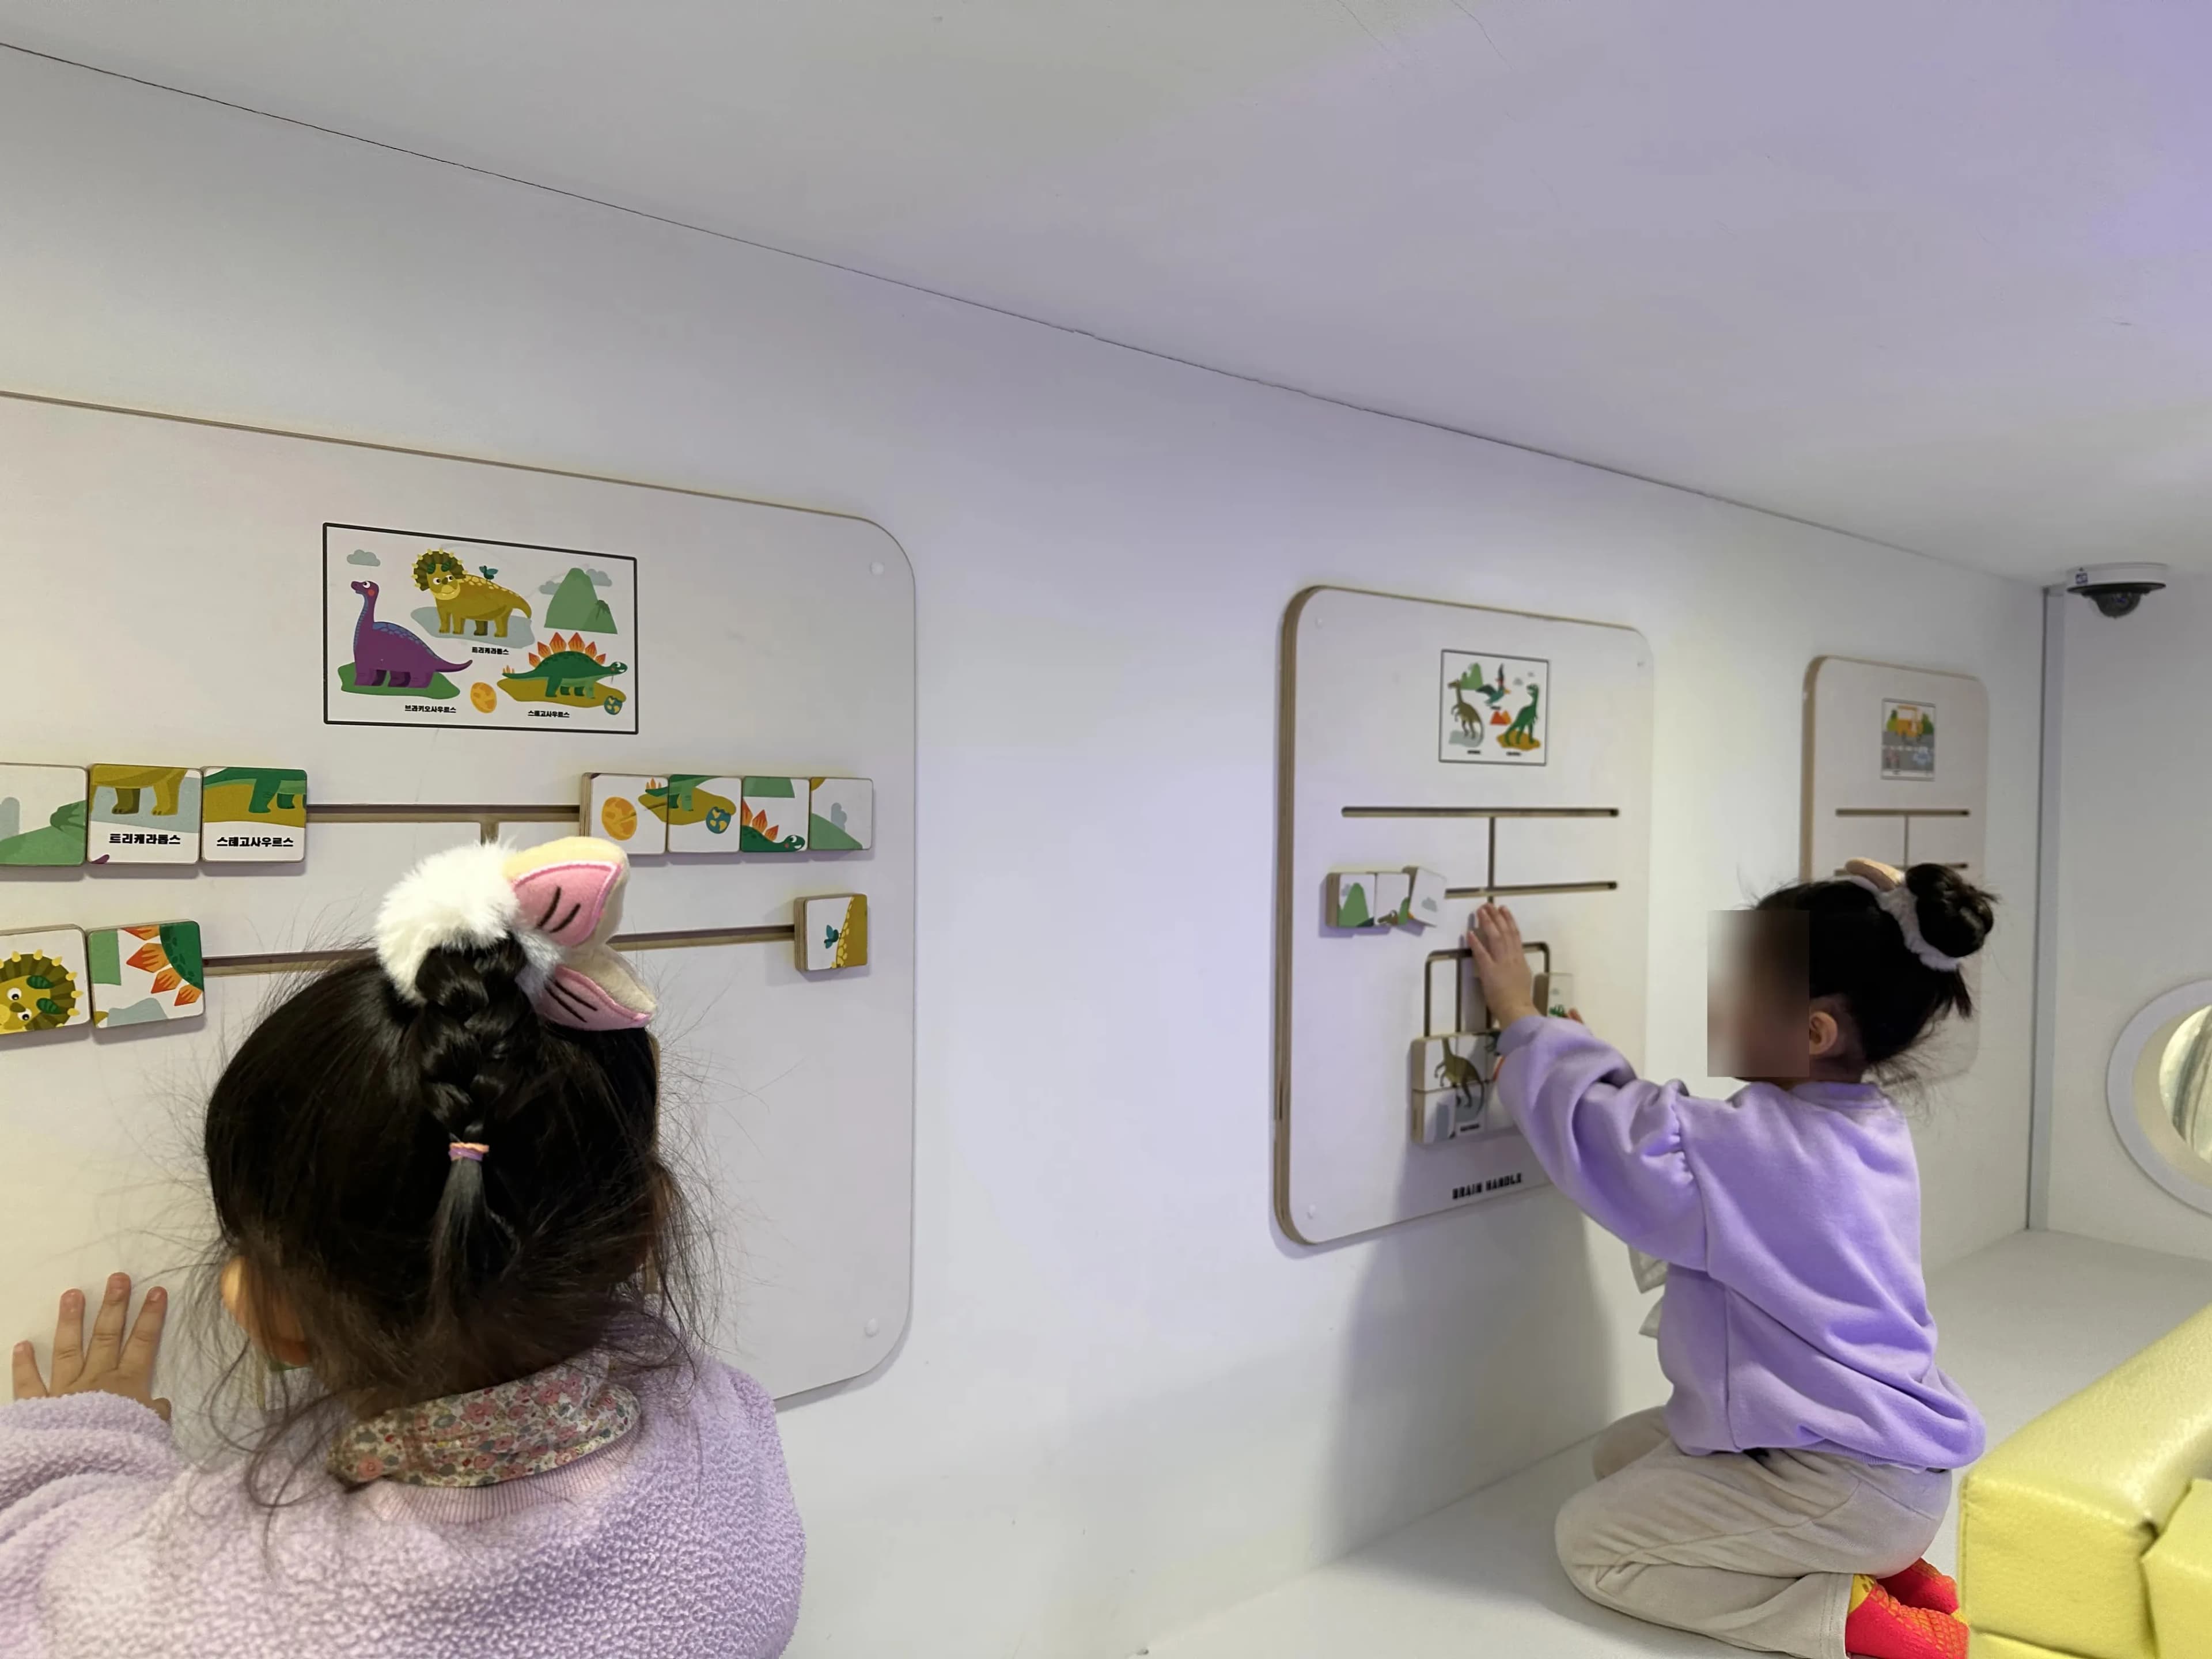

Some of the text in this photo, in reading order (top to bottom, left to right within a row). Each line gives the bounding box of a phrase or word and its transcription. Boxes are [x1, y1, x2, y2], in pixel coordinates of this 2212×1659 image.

[216, 836, 294, 847] 스테고사우르스
[1452, 1172, 1522, 1199] BRAIN HANDLE
